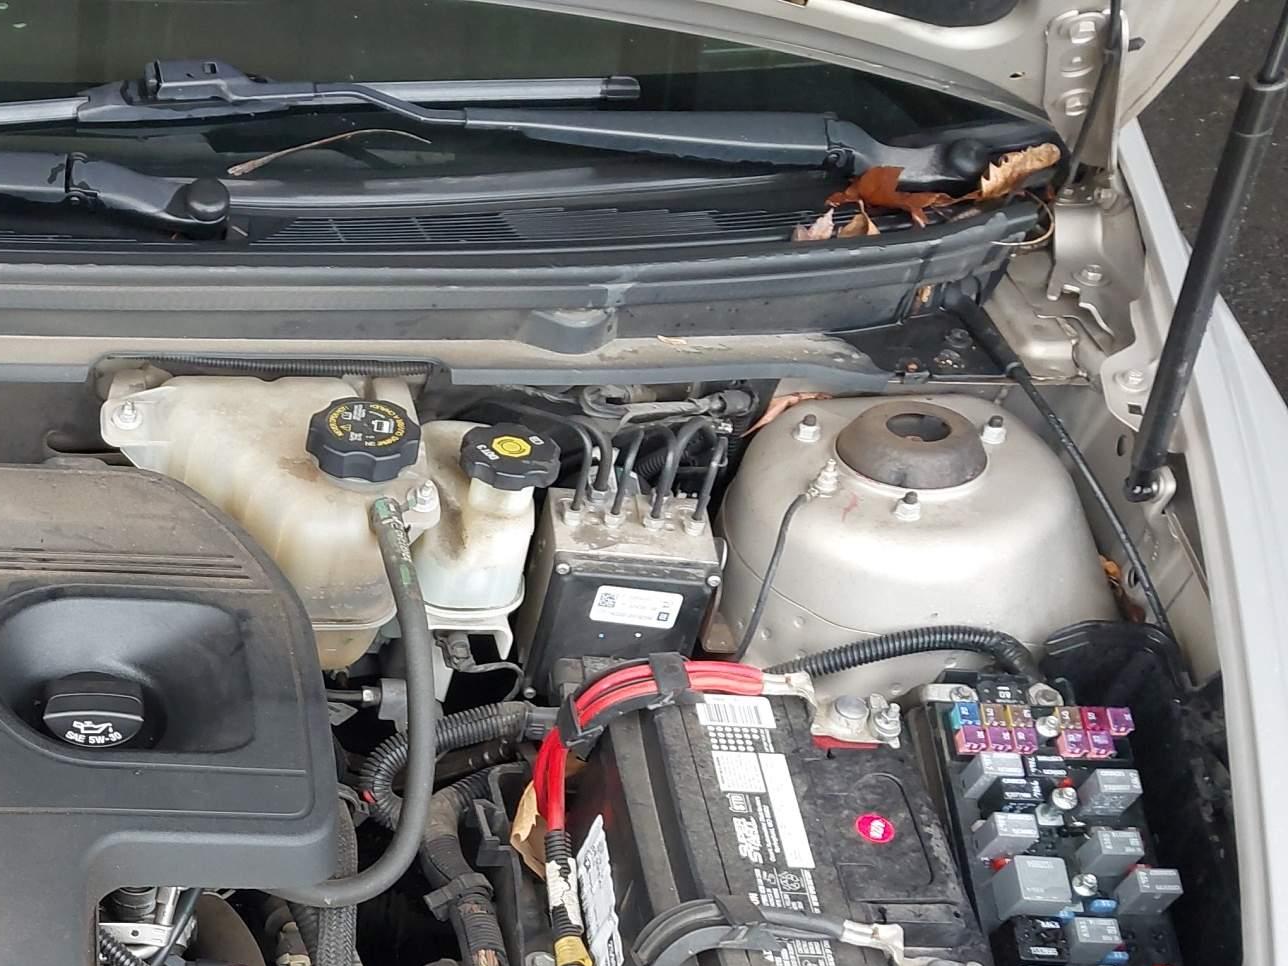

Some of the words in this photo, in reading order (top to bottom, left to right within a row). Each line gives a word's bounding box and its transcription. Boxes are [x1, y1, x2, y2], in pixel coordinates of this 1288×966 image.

[483, 449, 500, 460] DOT
[65, 731, 85, 743] SAE
[89, 731, 122, 744] 5W-30
